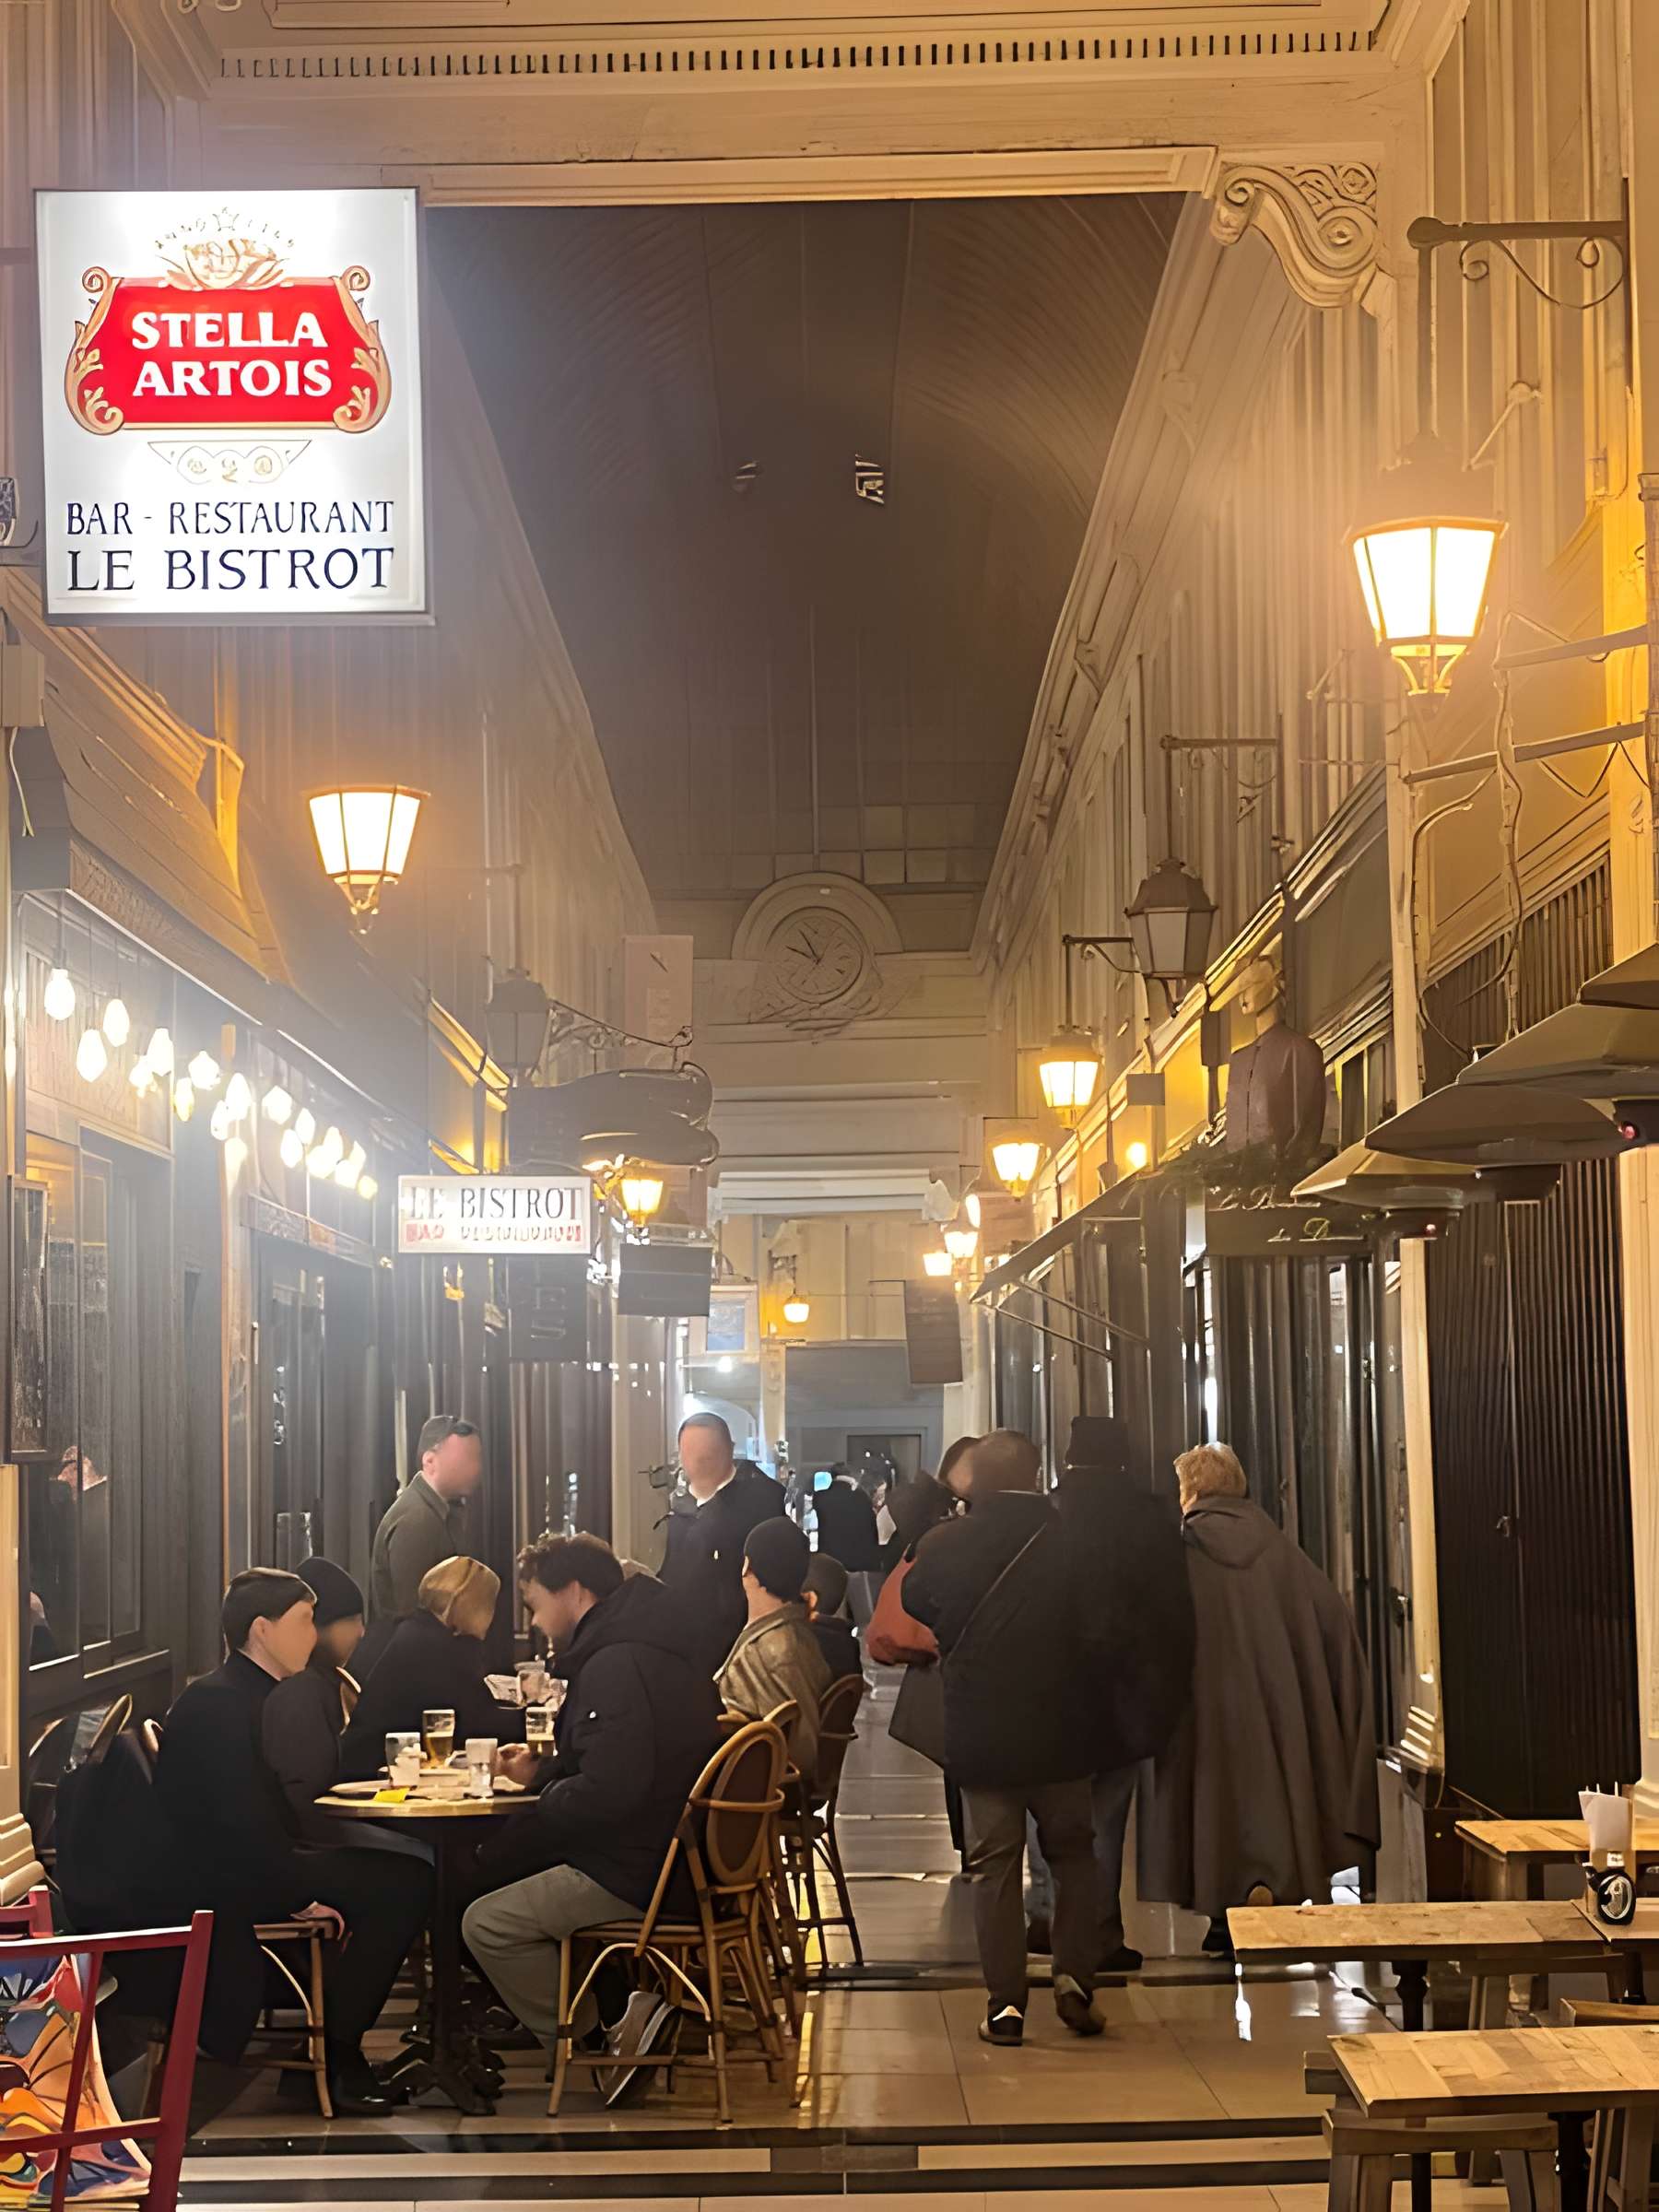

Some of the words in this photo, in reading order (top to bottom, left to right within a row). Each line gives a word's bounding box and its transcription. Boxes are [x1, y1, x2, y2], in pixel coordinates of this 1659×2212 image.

[132, 311, 329, 349] STELLA
[132, 359, 333, 397] ARTOIS
[66, 501, 133, 535] BAR
[170, 500, 394, 535] RESTAURANT
[66, 549, 135, 592] LE
[164, 547, 394, 591] BISTROT
[409, 1186, 444, 1219] LE
[460, 1186, 583, 1220] BISTROT
